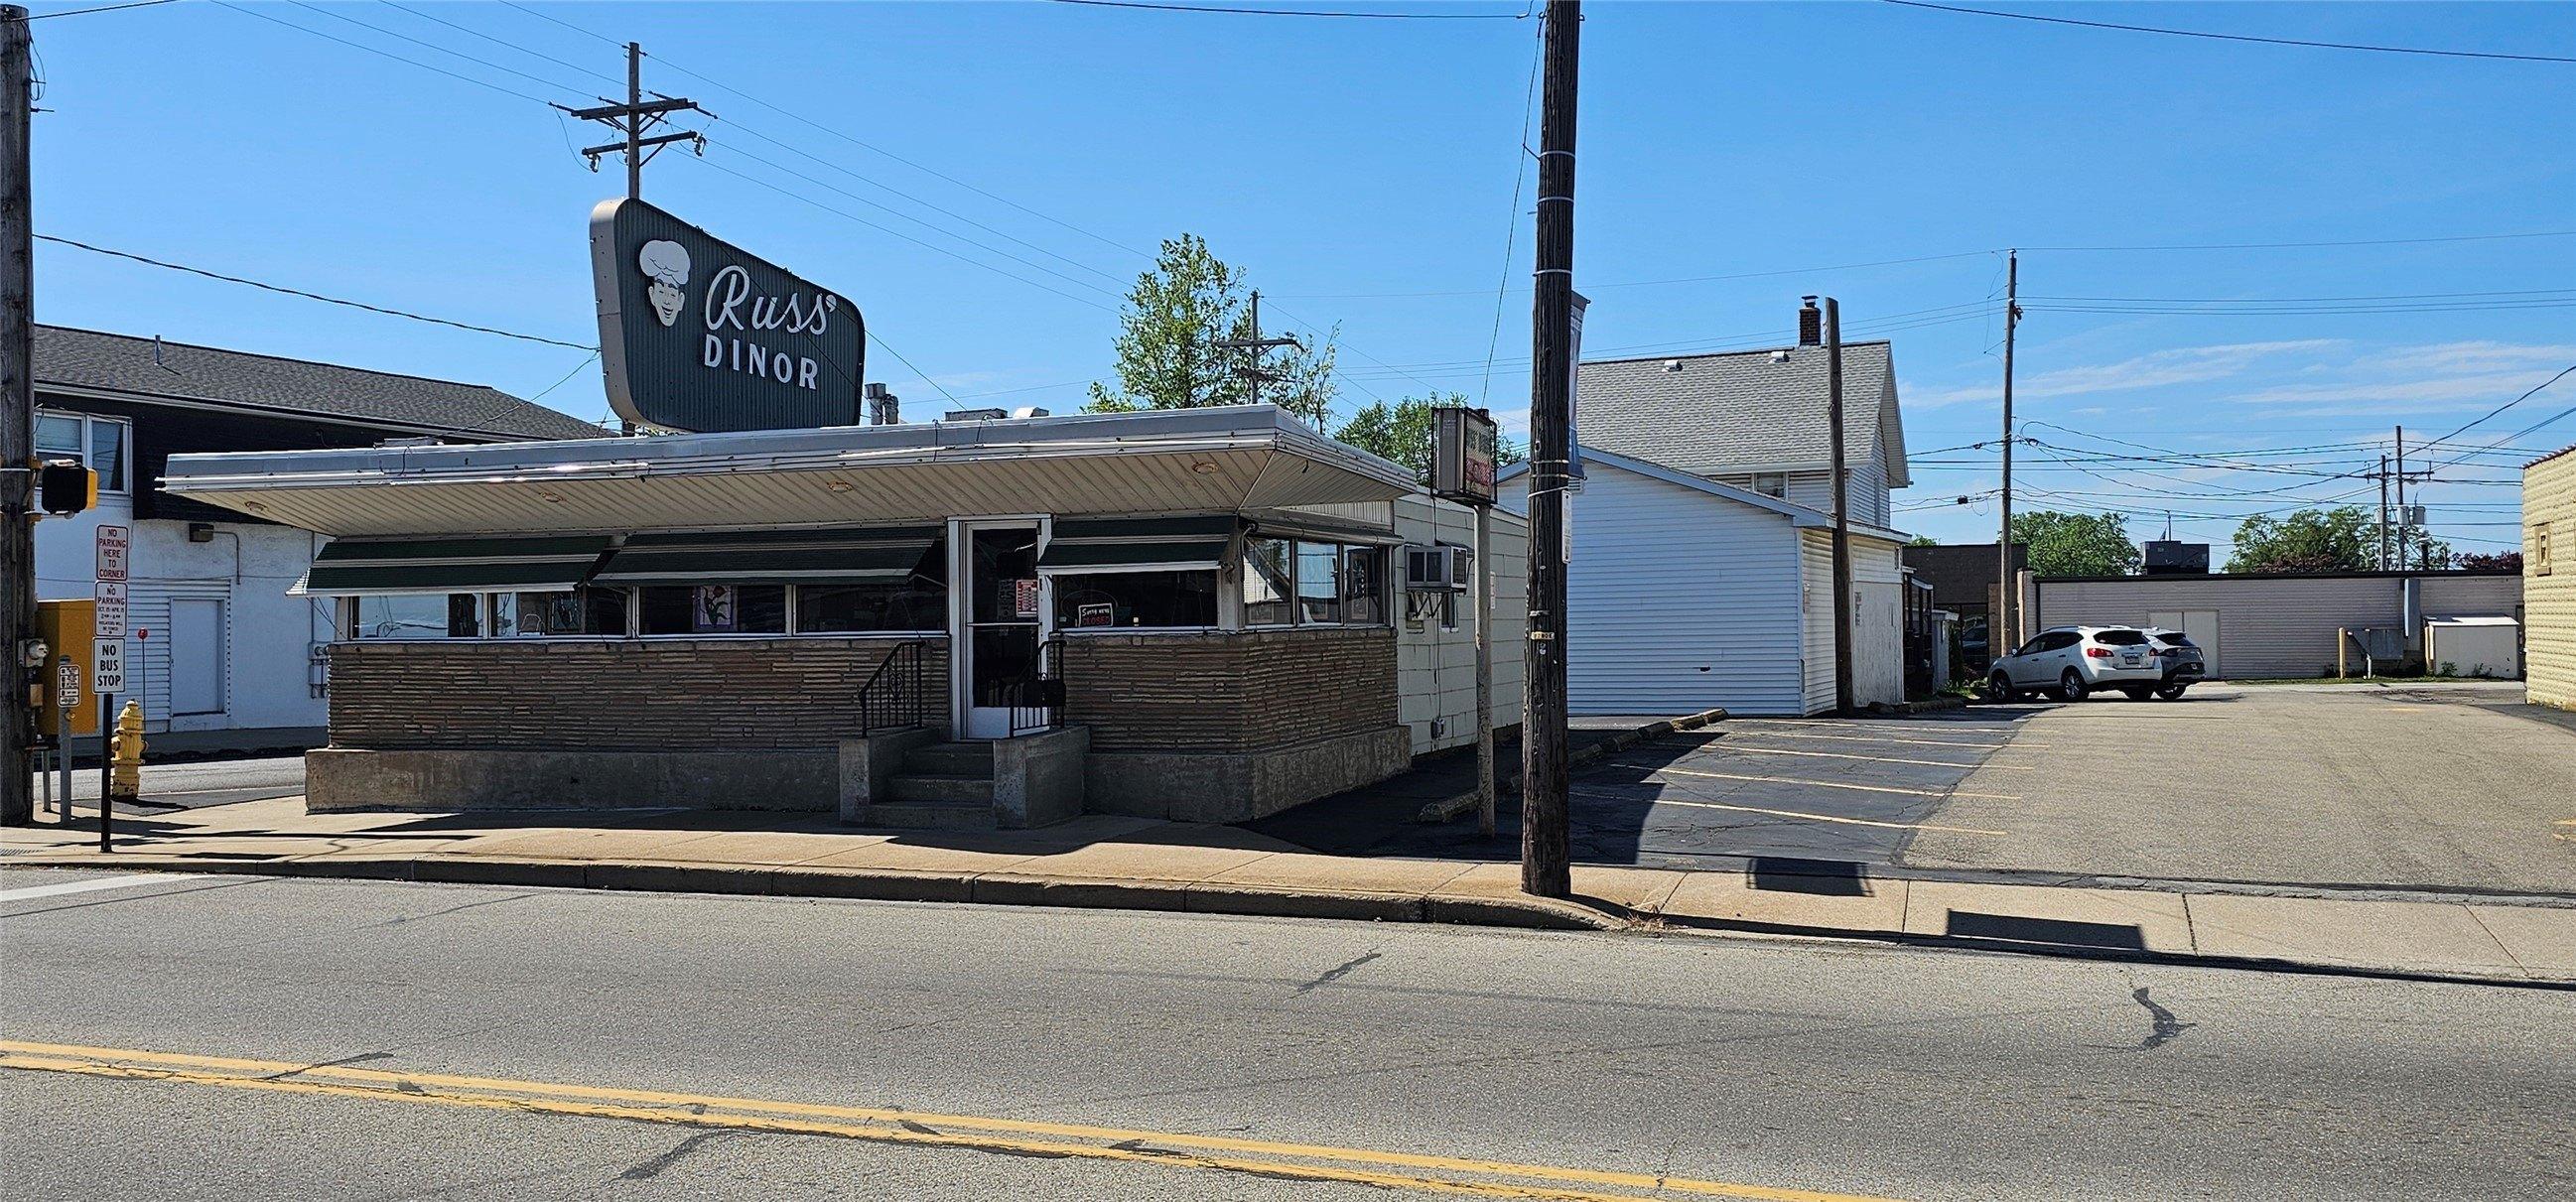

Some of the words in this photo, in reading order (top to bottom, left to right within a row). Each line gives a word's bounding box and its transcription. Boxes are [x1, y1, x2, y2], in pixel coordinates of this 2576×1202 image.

[704, 334, 819, 390] DINOR
[107, 528, 117, 537] NO
[99, 538, 126, 548] PARKING
[103, 549, 121, 558] HERE
[108, 559, 117, 568] TO
[99, 569, 125, 578] CORNER
[97, 597, 125, 605] PARKING
[102, 644, 116, 656] NO
[100, 660, 118, 671] BUS
[97, 675, 121, 687] STOP
